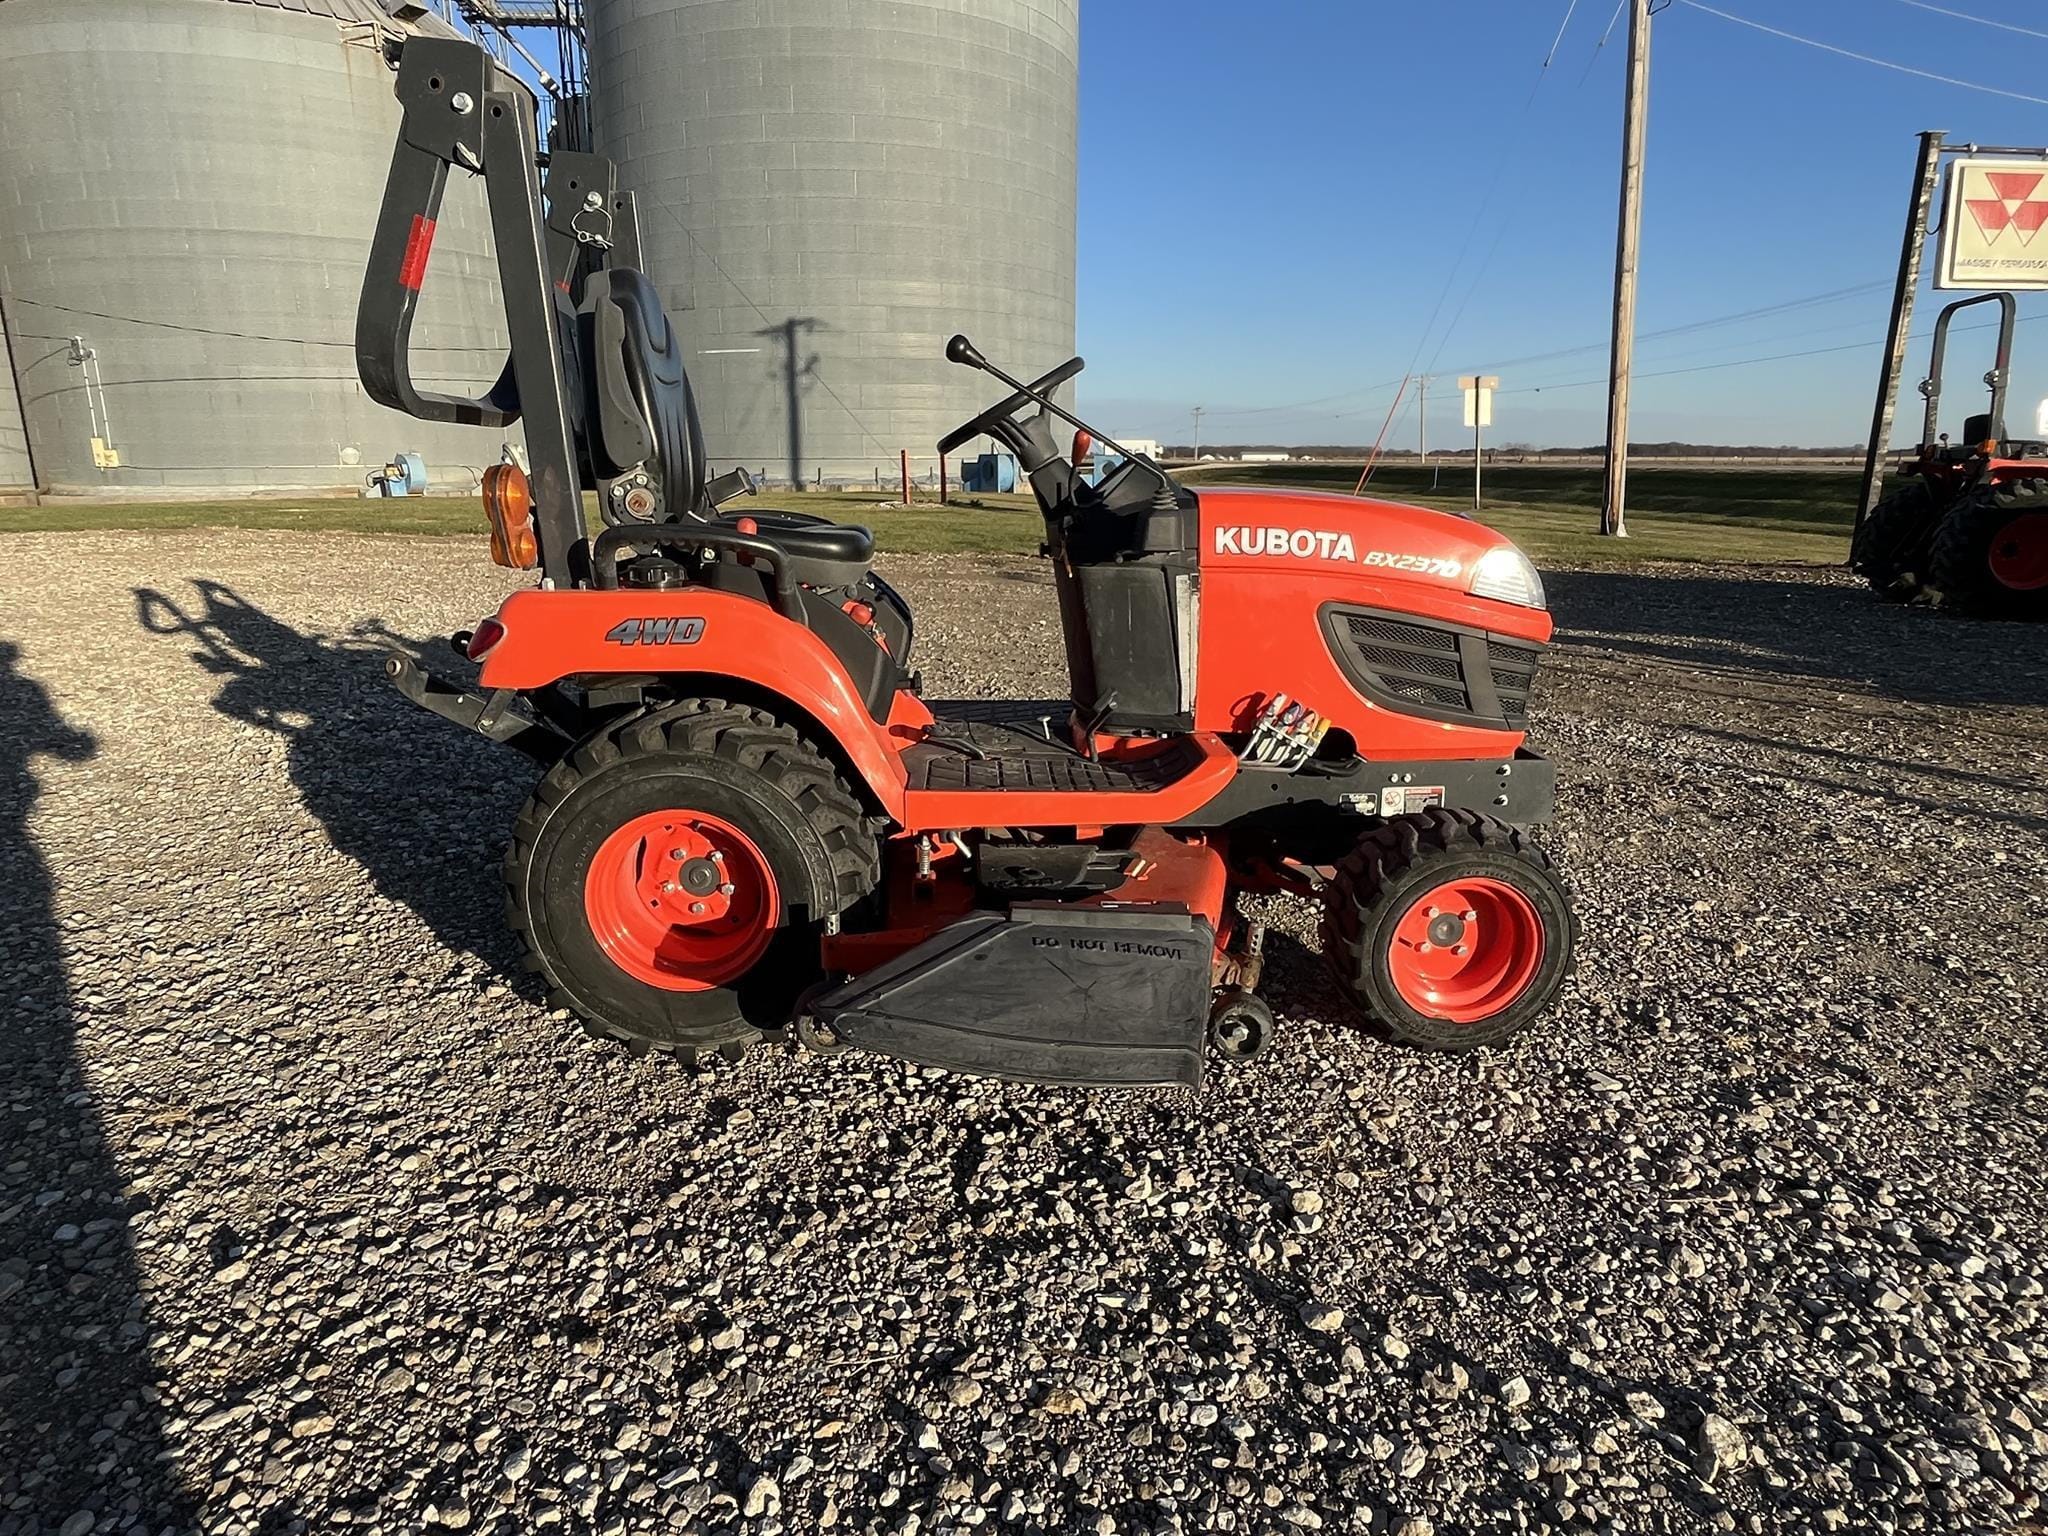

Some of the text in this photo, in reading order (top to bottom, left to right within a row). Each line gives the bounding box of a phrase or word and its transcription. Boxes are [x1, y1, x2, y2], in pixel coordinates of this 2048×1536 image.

[1214, 526, 1356, 562] KUBOTA
[1362, 551, 1462, 578] BX2370
[604, 616, 706, 645] 4WD
[1032, 936, 1060, 948] DO
[1070, 938, 1106, 952] NOT
